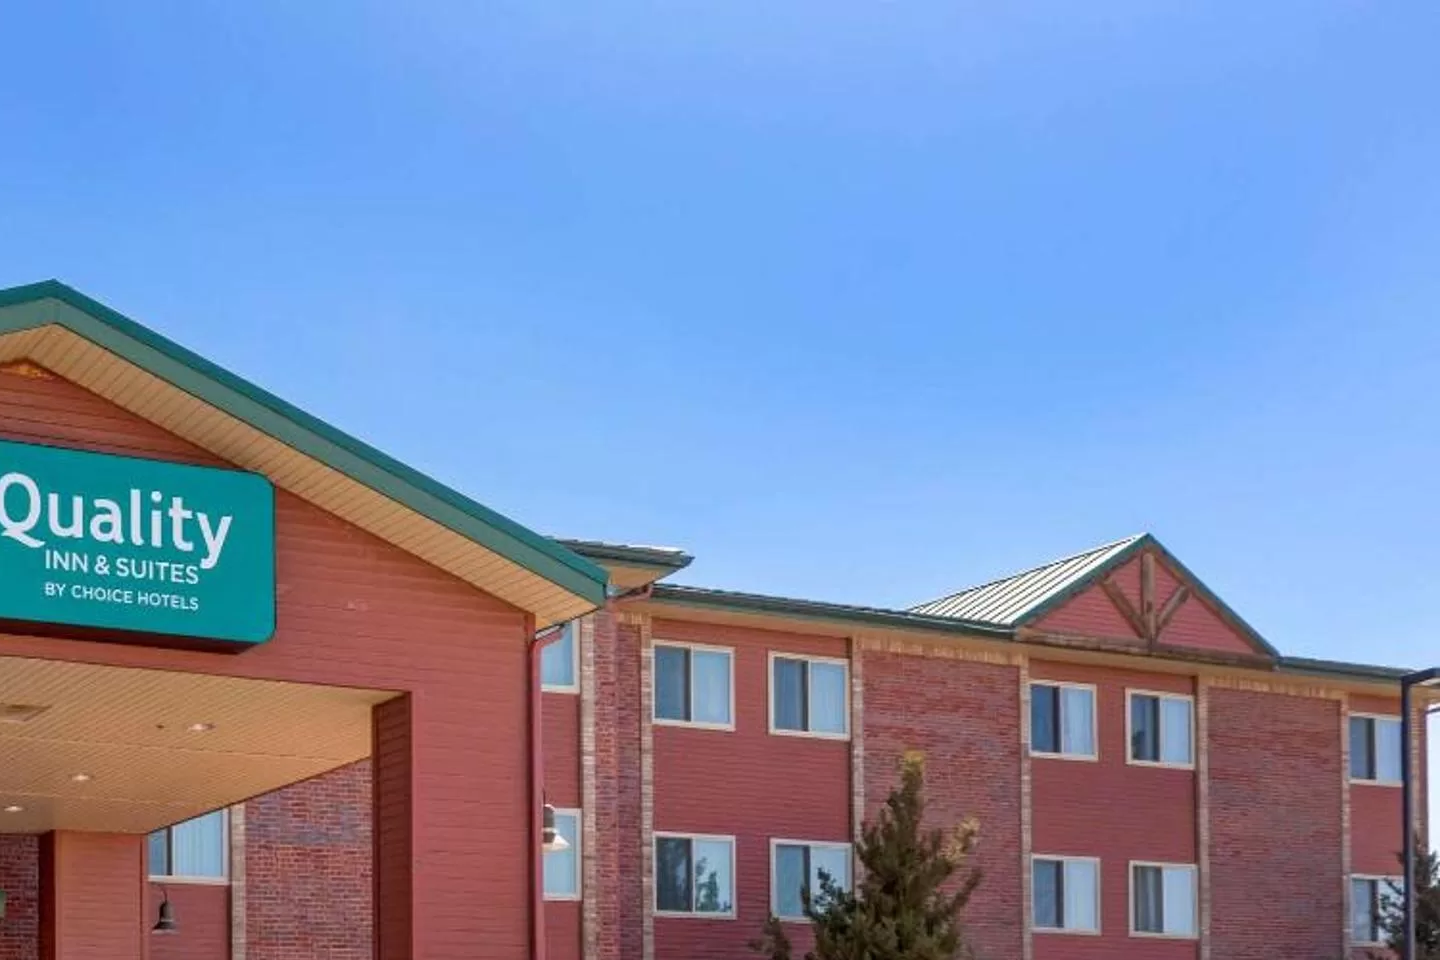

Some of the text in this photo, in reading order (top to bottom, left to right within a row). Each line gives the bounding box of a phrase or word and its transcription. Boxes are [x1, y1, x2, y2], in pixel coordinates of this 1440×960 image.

[45, 549, 199, 584] INN & SUITES
[45, 582, 199, 610] BY CHOICE HOTELS
